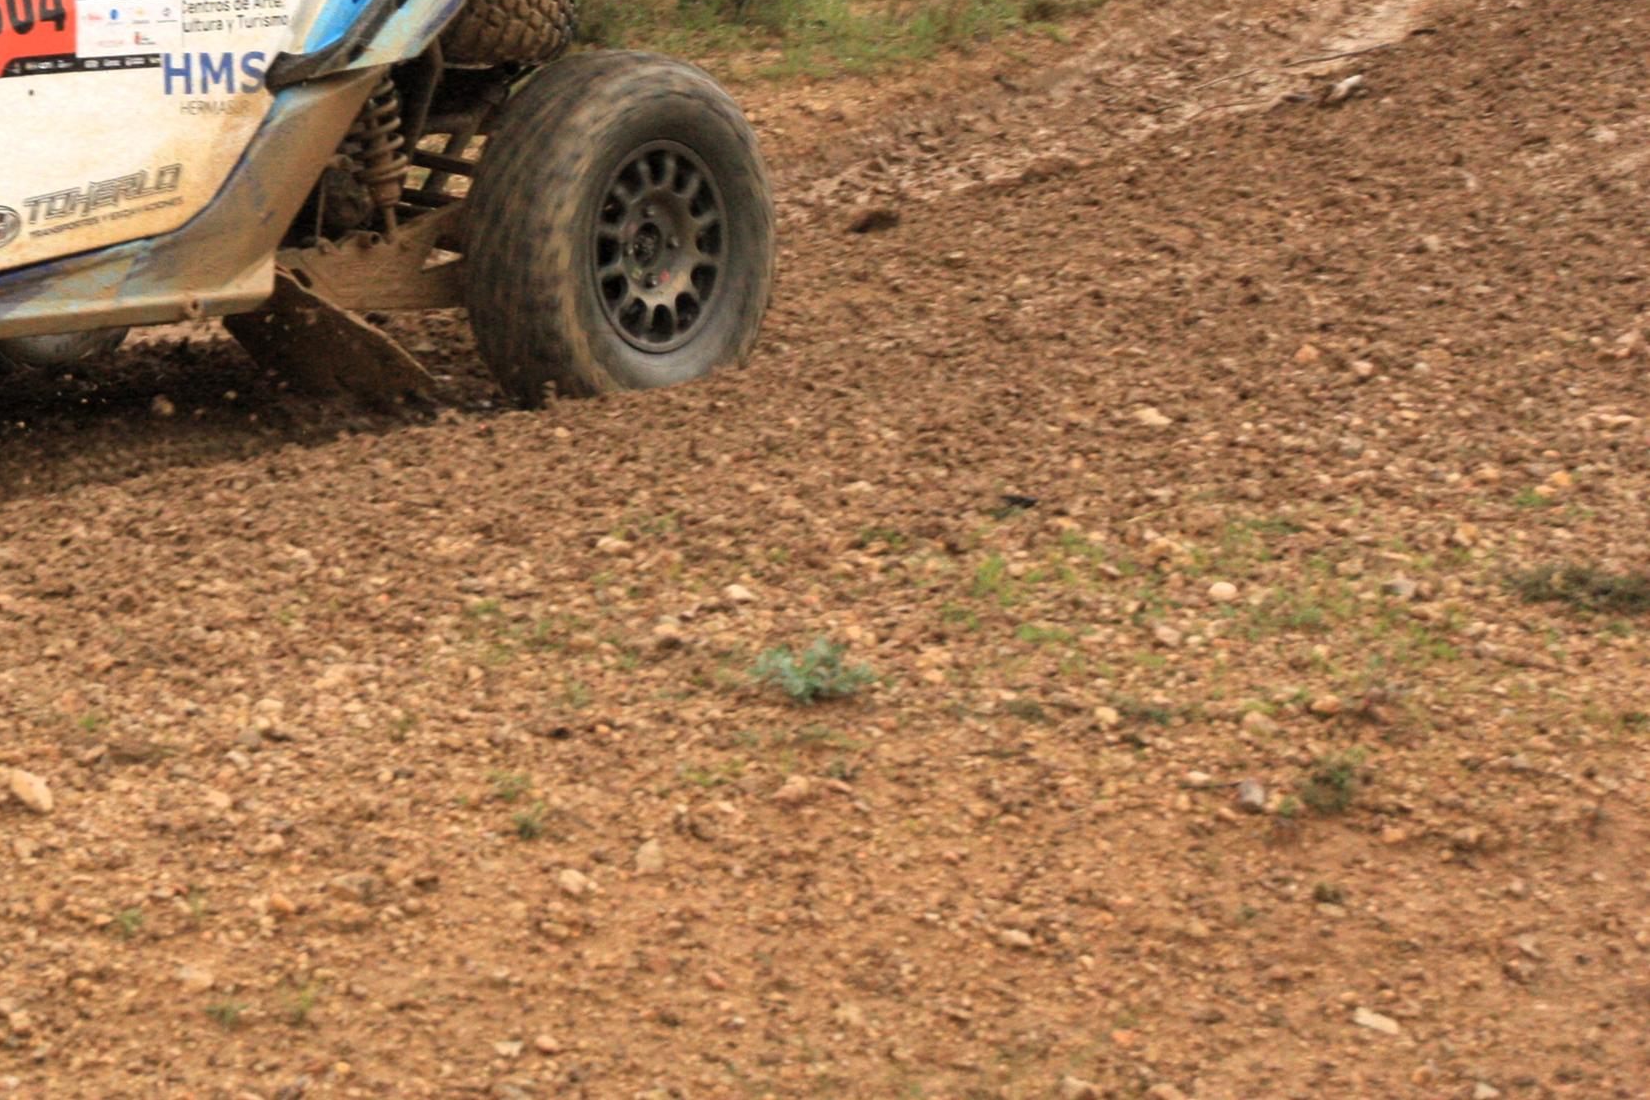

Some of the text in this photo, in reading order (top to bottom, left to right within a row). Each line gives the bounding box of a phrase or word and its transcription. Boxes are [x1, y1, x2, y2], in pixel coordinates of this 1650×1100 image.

[182, 13, 290, 34] ultura y Turismo
[163, 51, 267, 95] HMS
